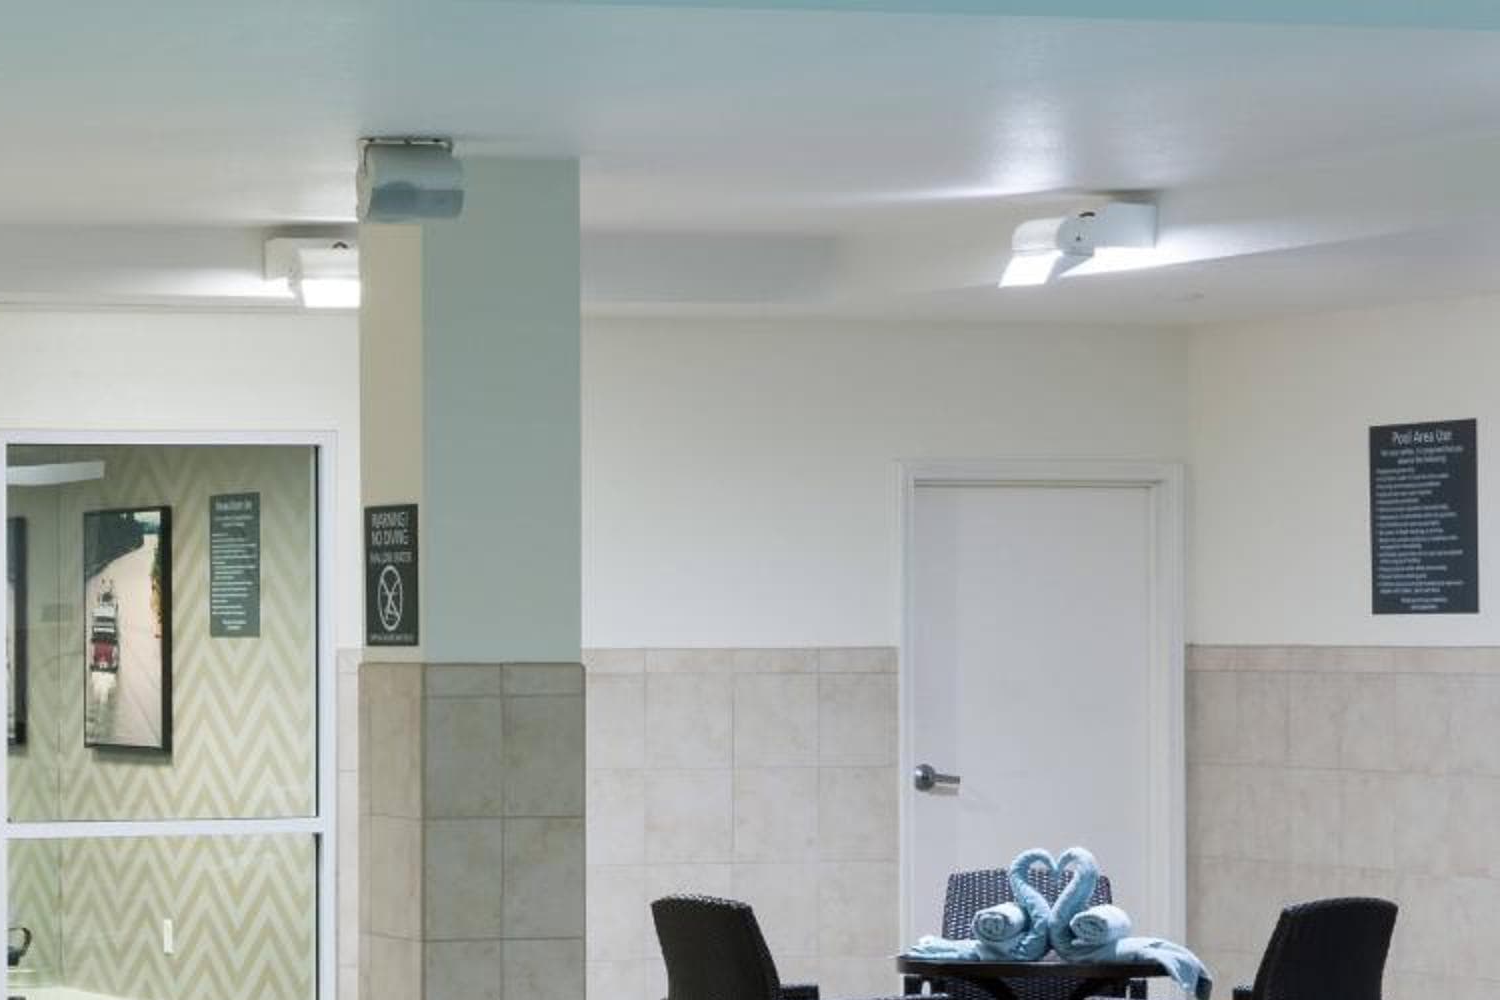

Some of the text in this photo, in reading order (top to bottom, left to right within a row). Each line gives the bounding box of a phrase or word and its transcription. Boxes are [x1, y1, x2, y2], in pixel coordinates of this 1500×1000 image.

[1392, 431, 1412, 445] Pool
[1413, 430, 1434, 442] Area
[371, 529, 382, 545] NO
